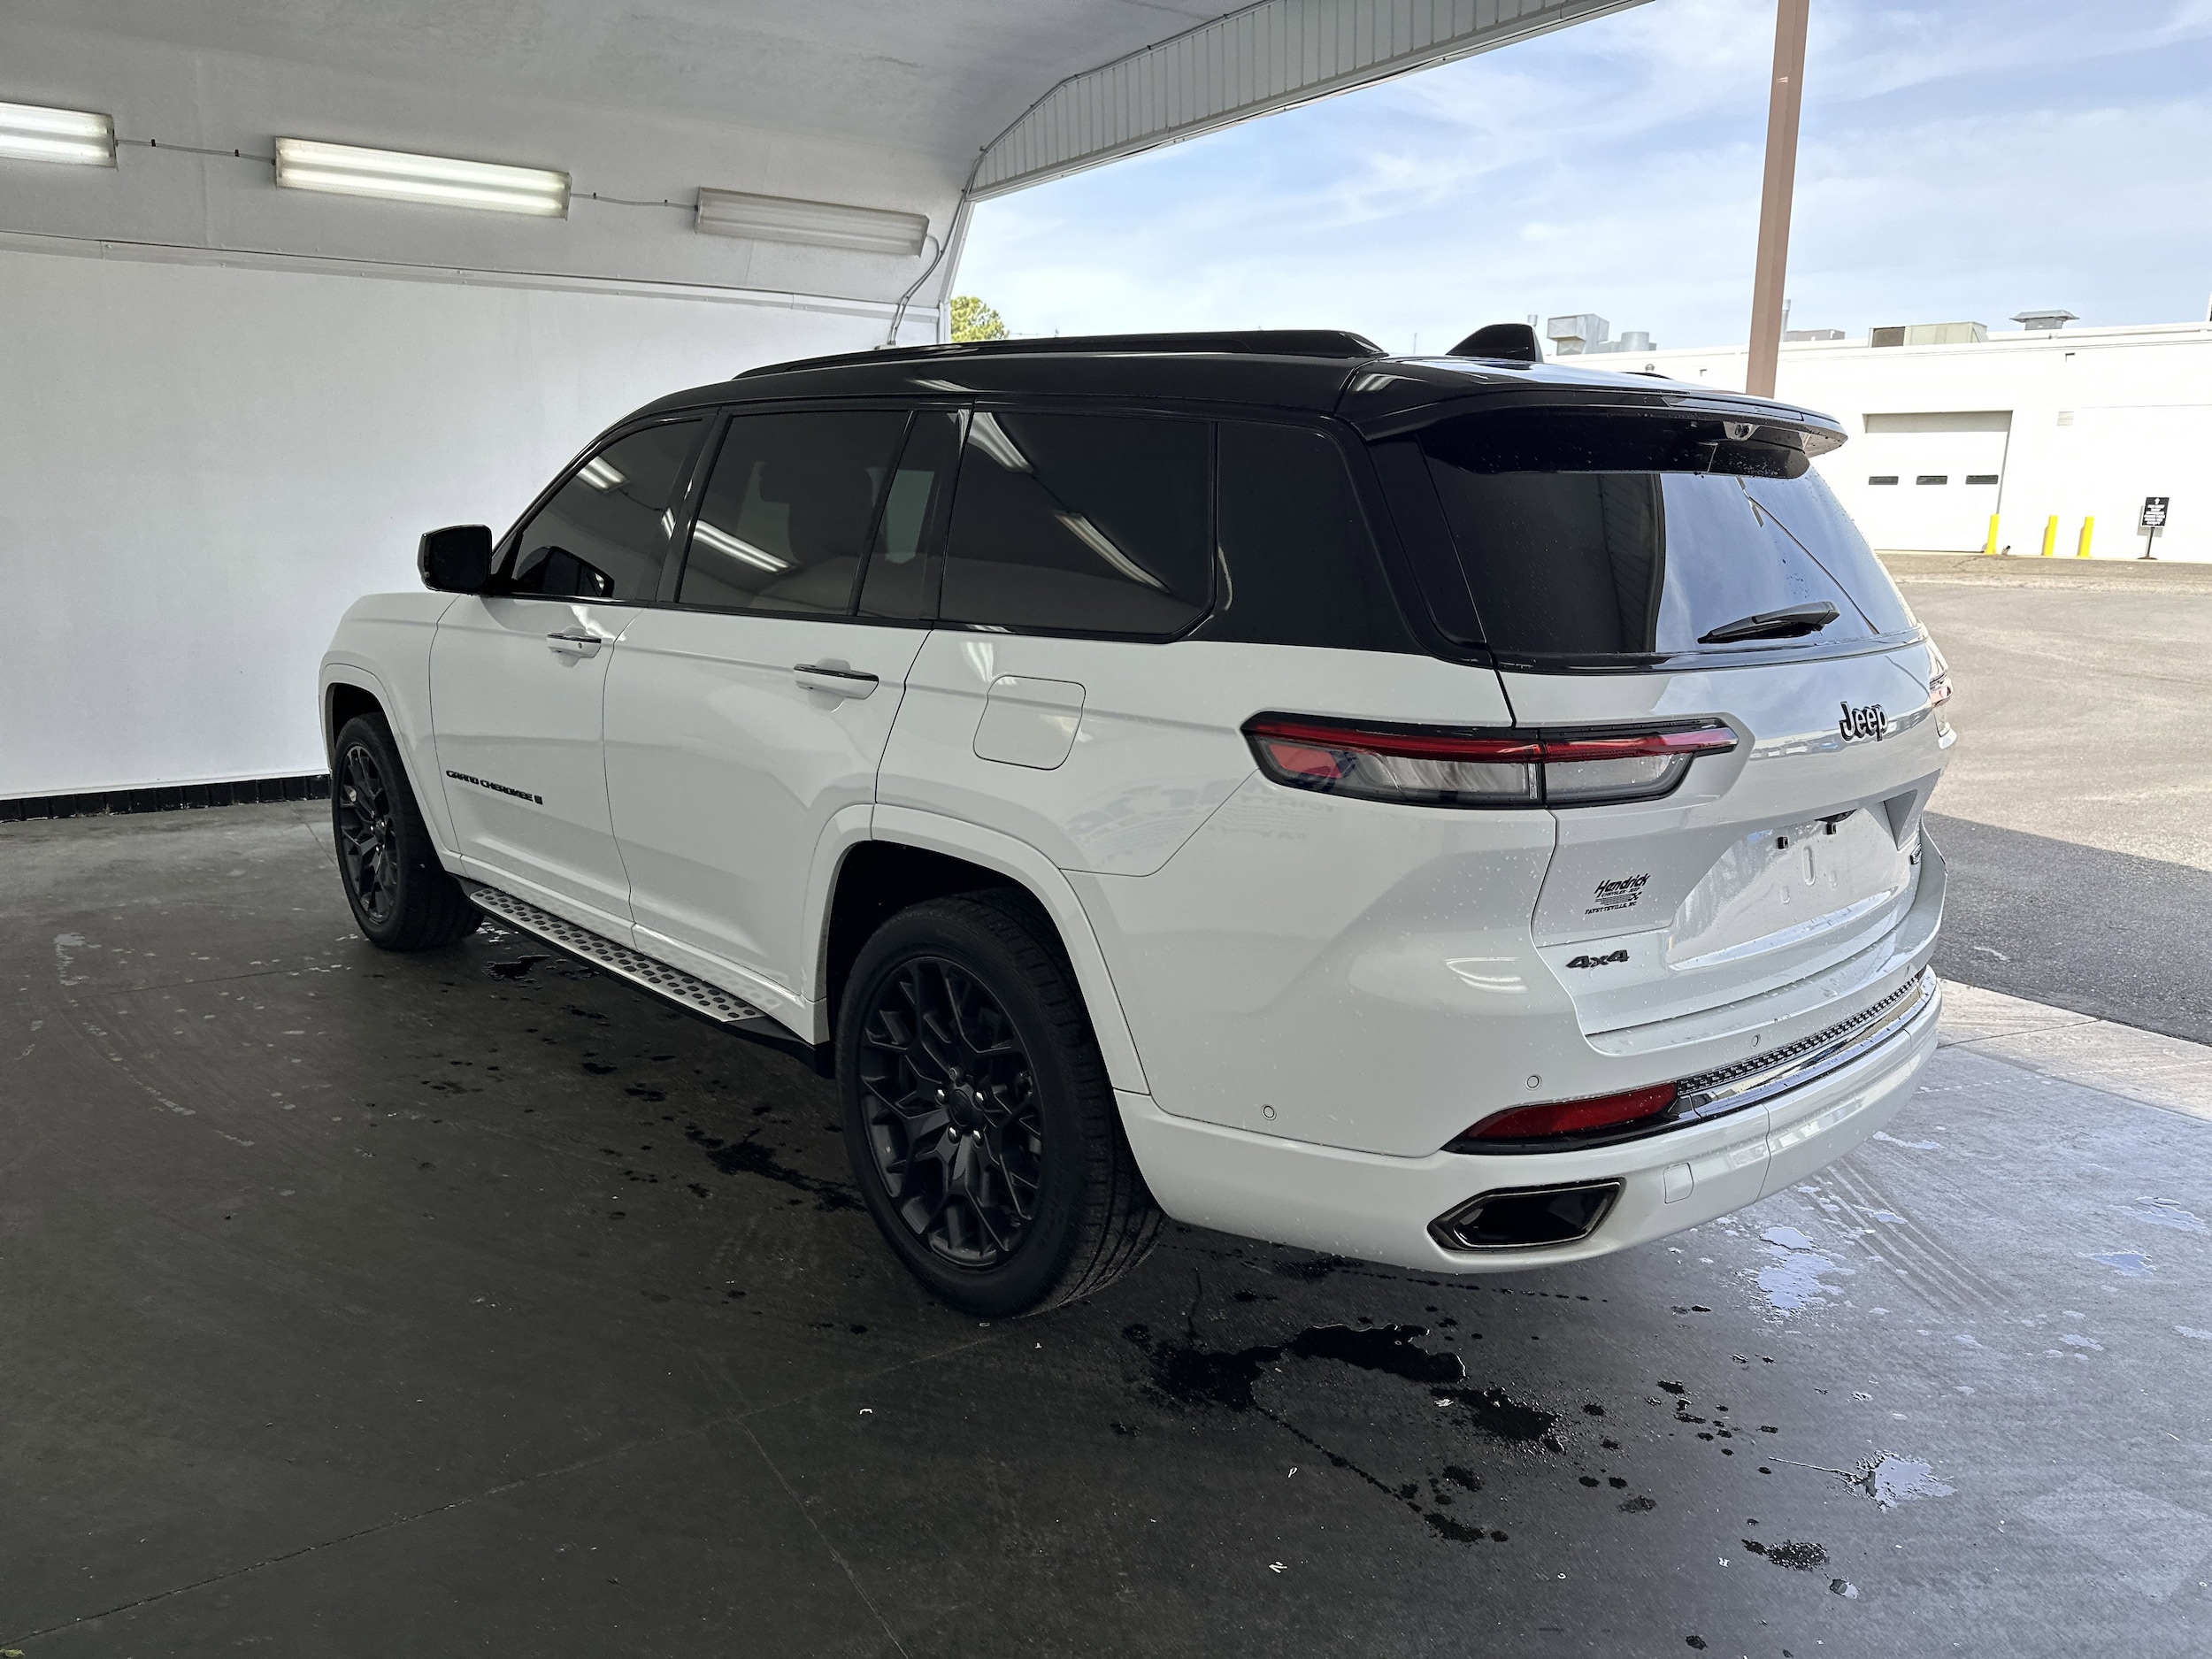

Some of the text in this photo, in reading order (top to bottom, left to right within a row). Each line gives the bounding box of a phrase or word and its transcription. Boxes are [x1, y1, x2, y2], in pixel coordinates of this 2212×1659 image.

[1839, 701, 1889, 742] Jeep
[445, 770, 480, 786] GRAND
[480, 780, 534, 802] CHEROKEE
[1594, 872, 1651, 898] Hendrick
